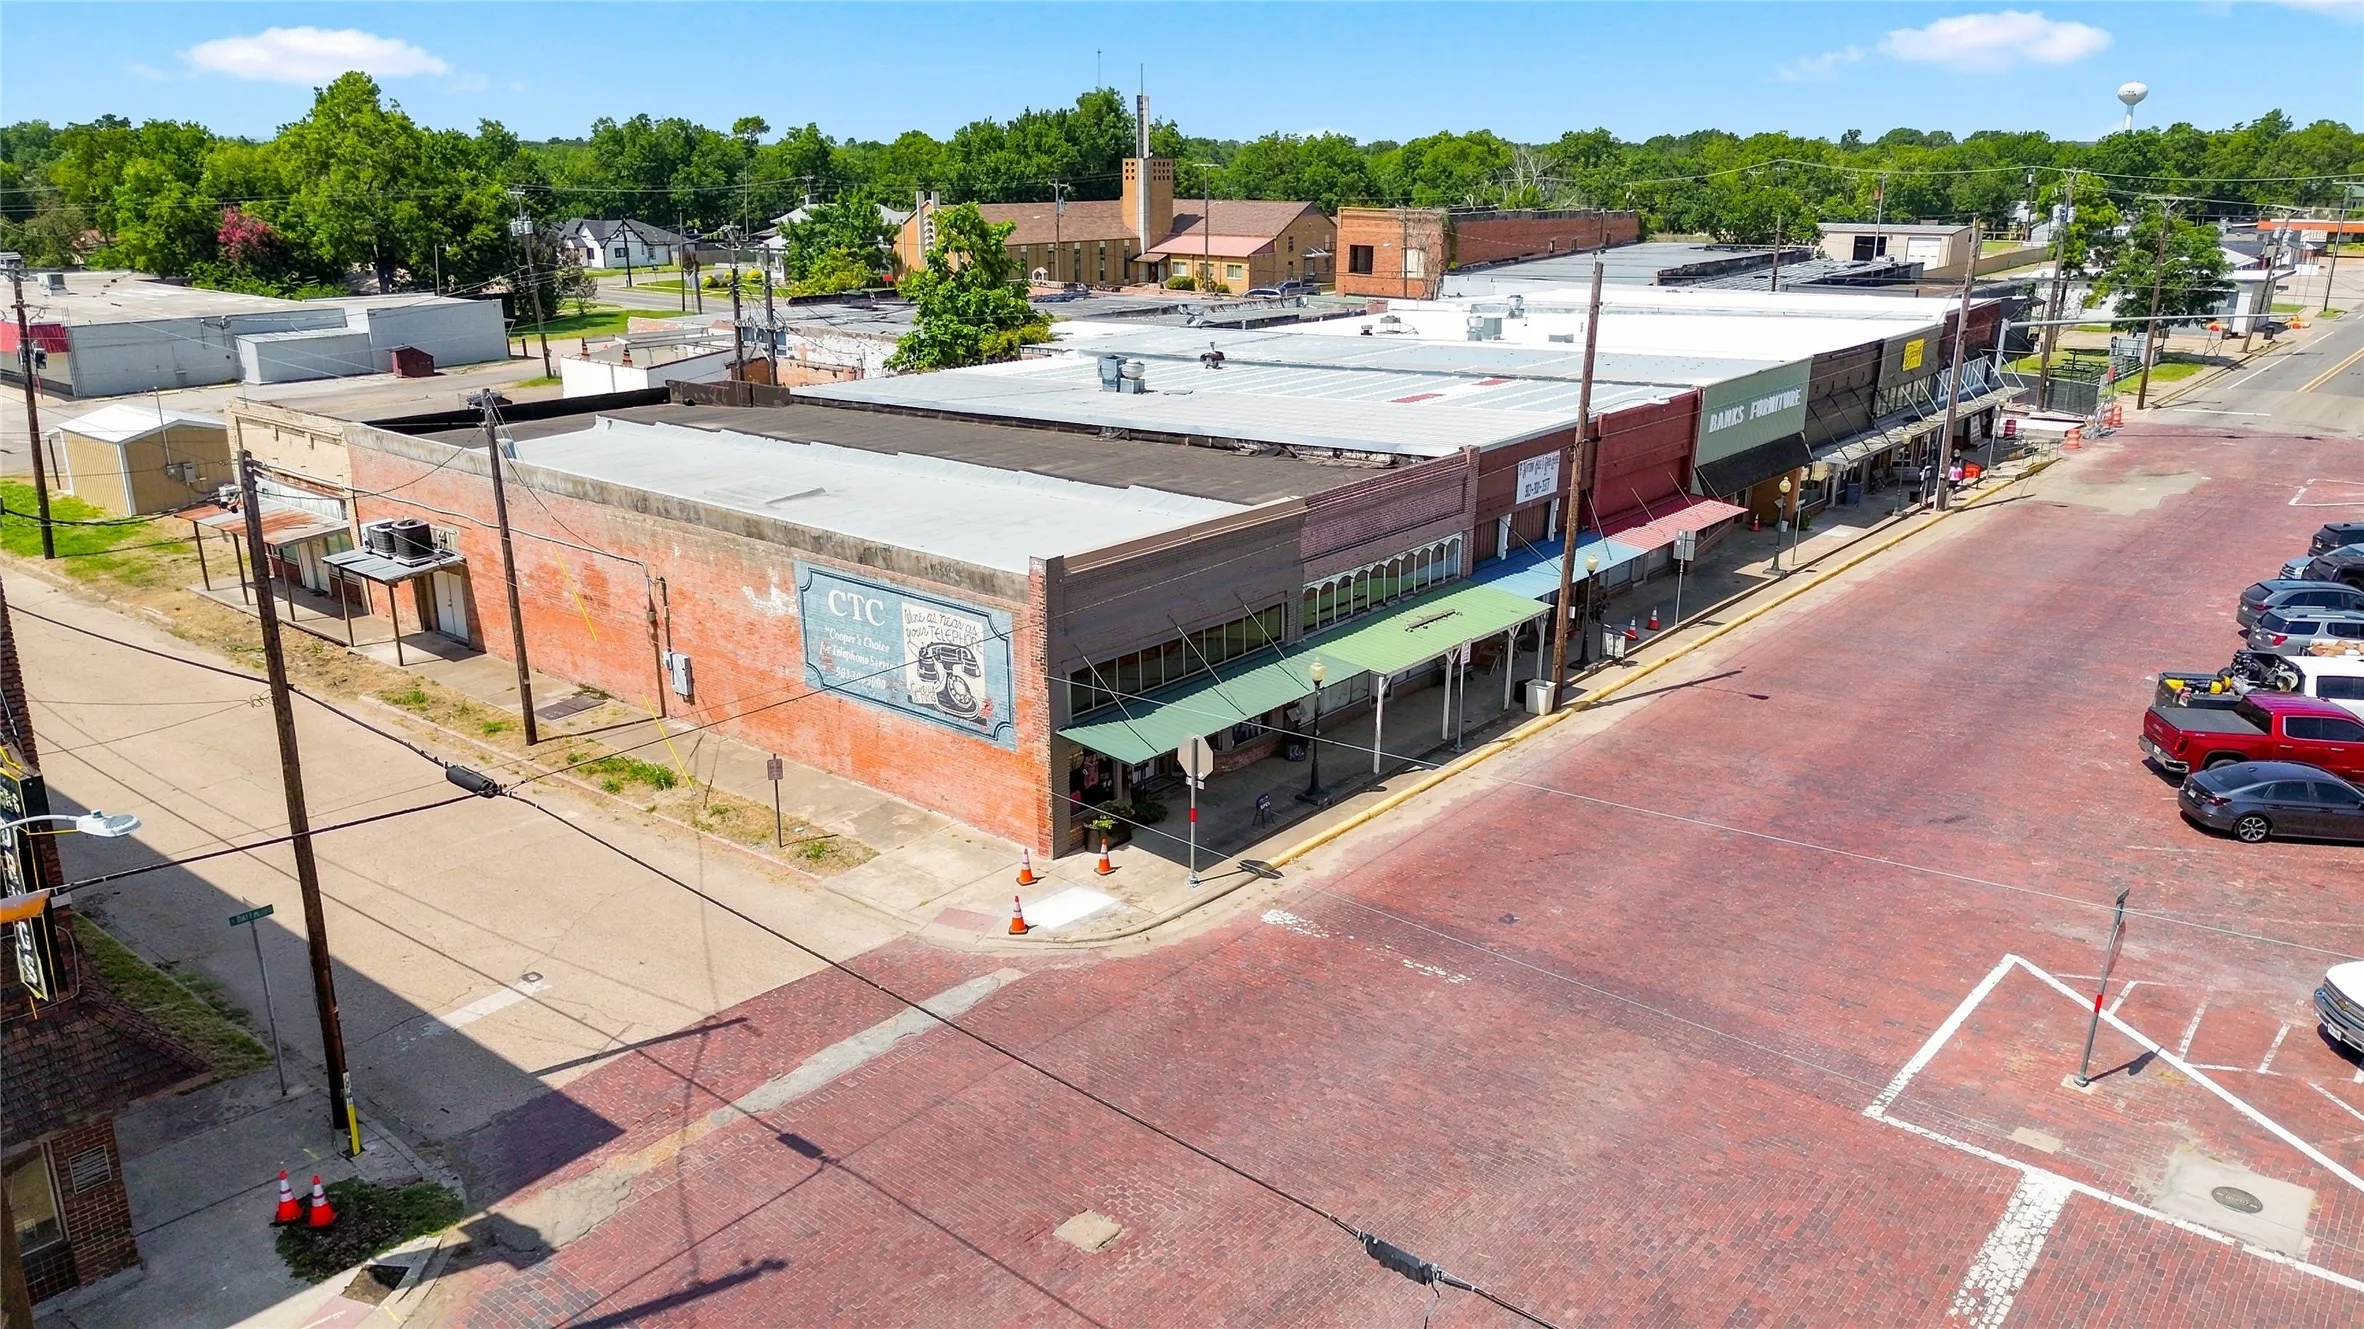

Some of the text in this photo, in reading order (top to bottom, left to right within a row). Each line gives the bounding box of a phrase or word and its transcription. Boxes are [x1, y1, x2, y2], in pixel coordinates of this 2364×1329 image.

[1708, 388, 1801, 433] BANKS FURNITURE
[828, 589, 885, 627] CTC
[939, 614, 964, 630] near
[832, 645, 870, 666] Telephone
[863, 637, 890, 653] Choice
